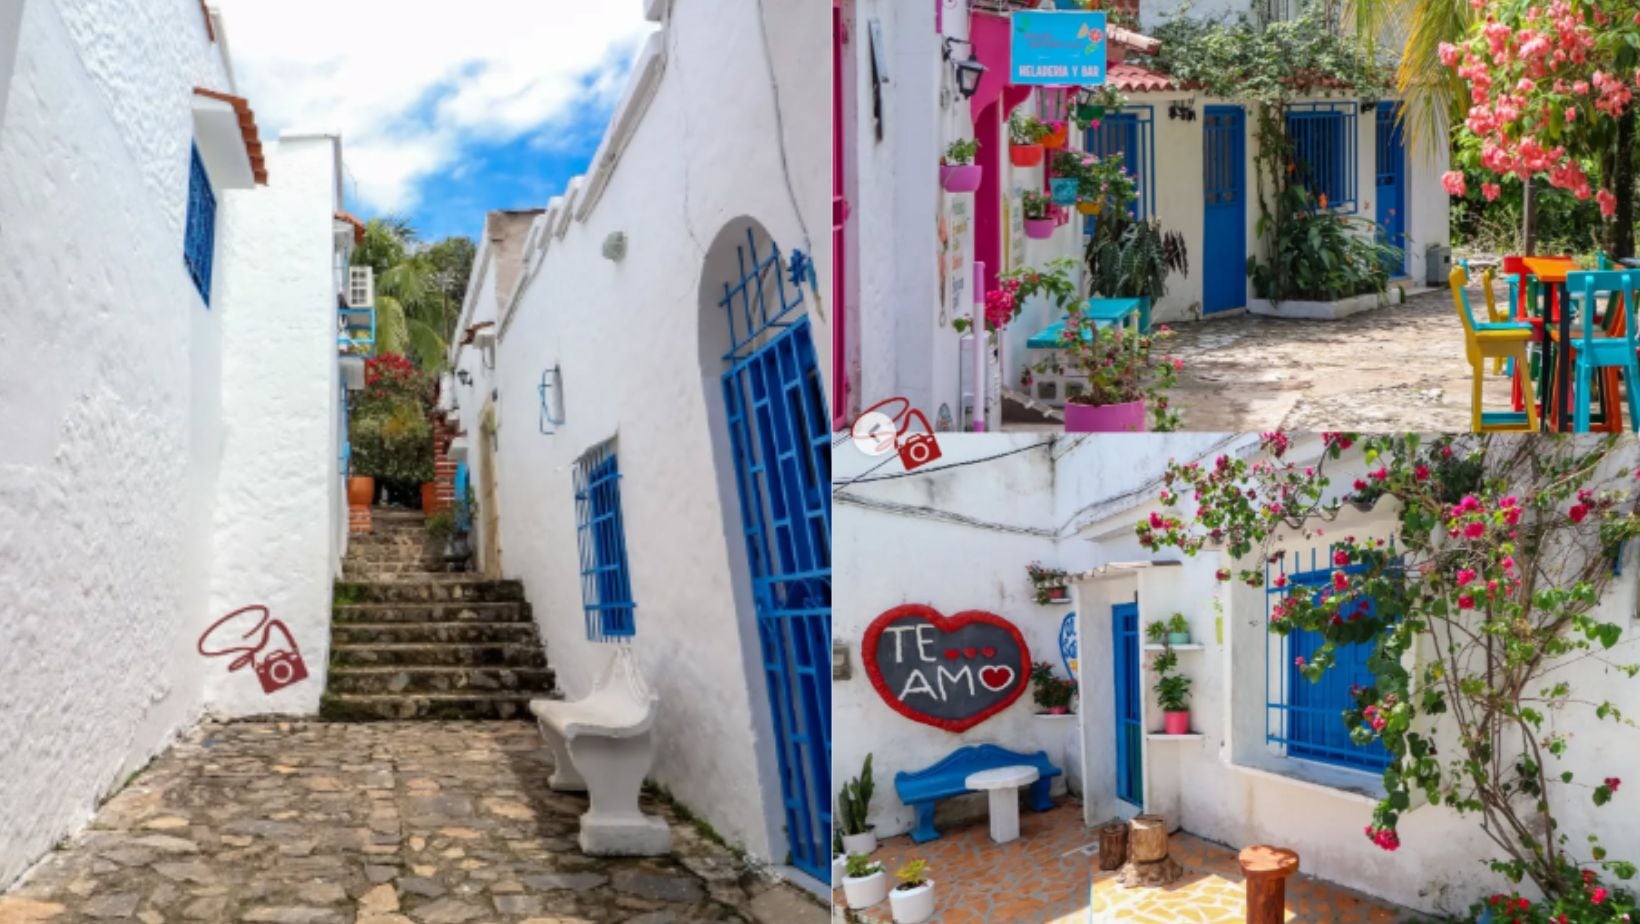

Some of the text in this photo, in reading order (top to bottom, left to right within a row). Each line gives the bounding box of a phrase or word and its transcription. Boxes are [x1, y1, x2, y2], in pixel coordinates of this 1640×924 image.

[1072, 65, 1079, 77] Y
[1081, 65, 1099, 77] BAR
[883, 624, 937, 664] TE
